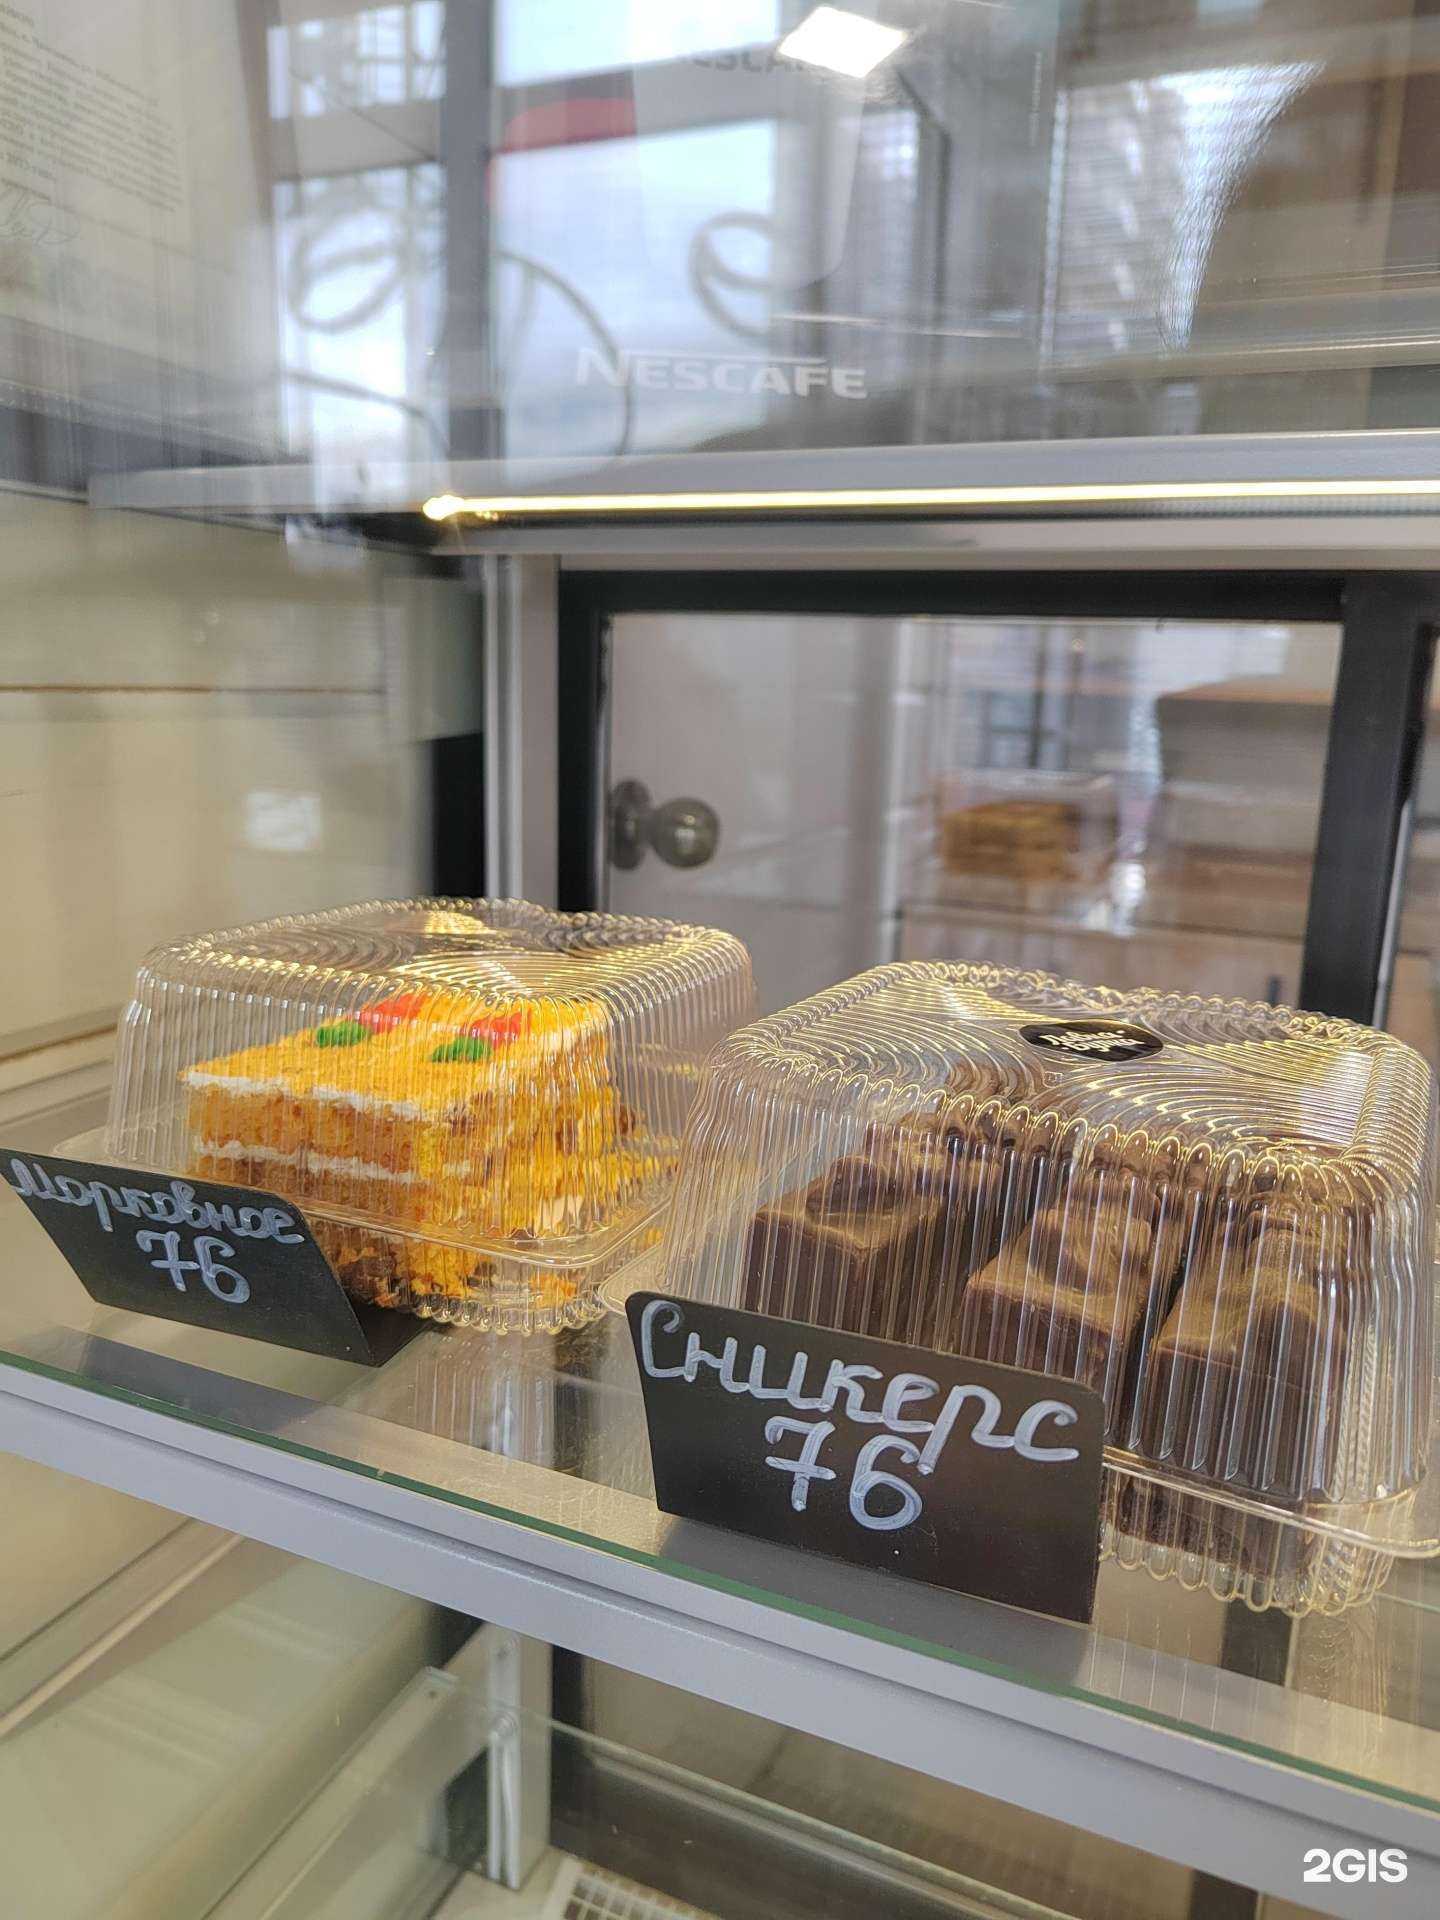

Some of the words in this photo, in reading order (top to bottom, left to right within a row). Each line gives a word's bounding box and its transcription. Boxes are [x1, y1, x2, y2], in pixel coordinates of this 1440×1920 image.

[11, 1158, 305, 1244] Морковное
[136, 1230, 250, 1303] 76
[641, 1300, 1079, 1475] Сникерс
[765, 1415, 923, 1531] 76
